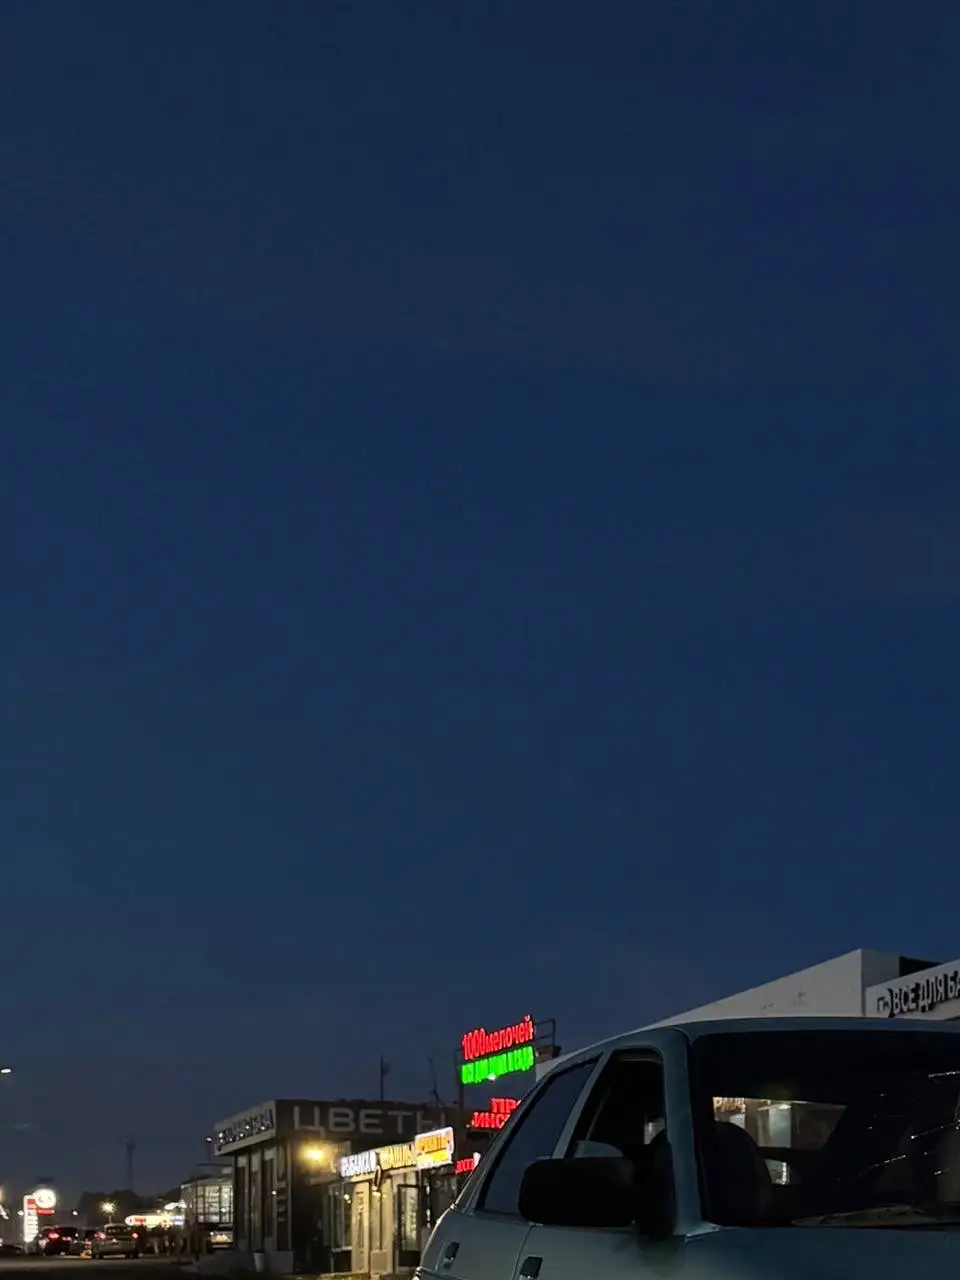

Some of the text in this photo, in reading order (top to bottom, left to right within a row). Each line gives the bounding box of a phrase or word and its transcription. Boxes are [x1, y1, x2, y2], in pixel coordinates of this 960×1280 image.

[891, 983, 917, 1015] ВСЕ
[918, 975, 945, 1012] ДЛЯ
[293, 1105, 447, 1138] ЦВЕТЫ
